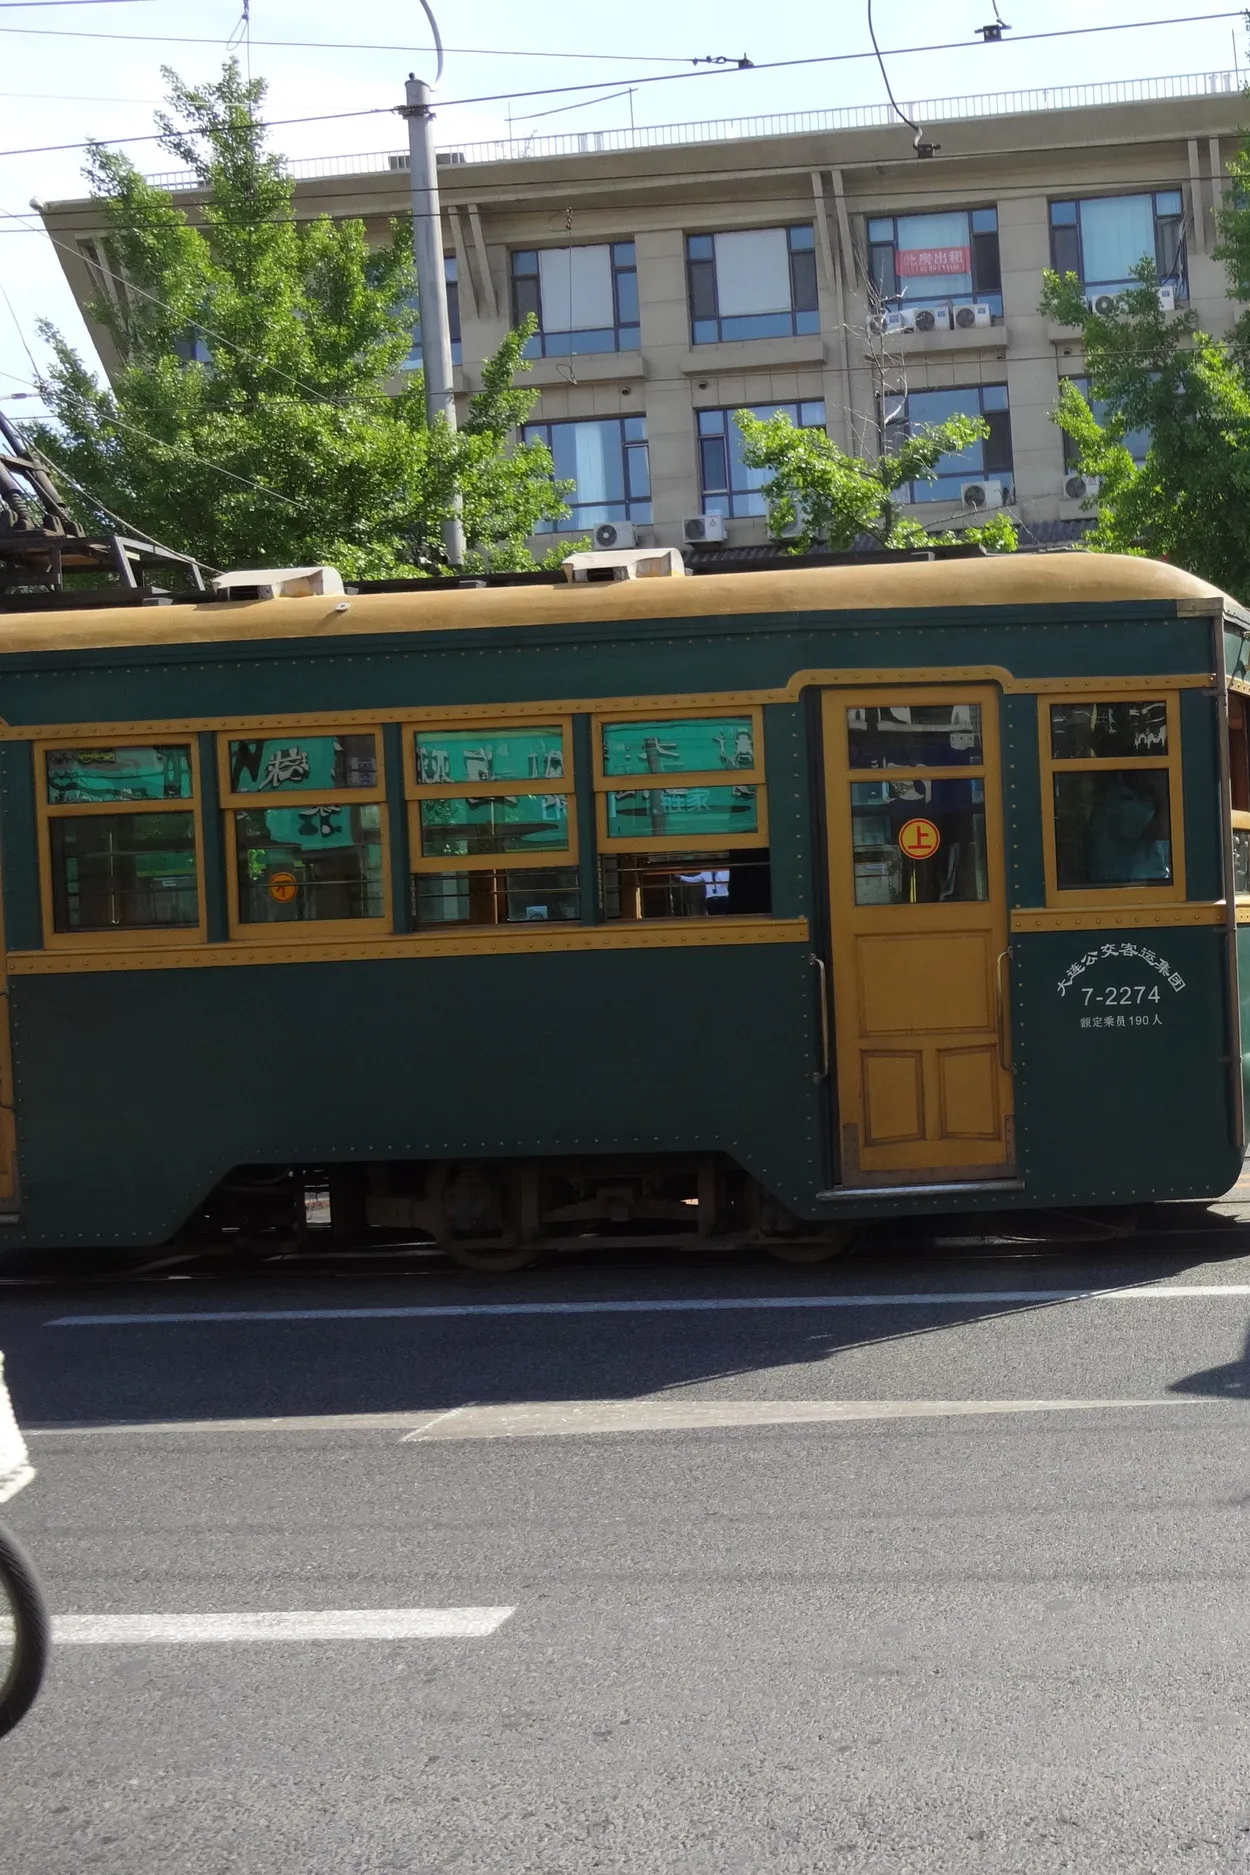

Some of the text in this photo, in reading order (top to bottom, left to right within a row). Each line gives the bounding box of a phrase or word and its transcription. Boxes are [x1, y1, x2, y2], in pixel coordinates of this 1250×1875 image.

[906, 825, 933, 849] 上
[1057, 942, 1186, 997] 大连公交客运集团
[1081, 985, 1161, 1006] 7-2274
